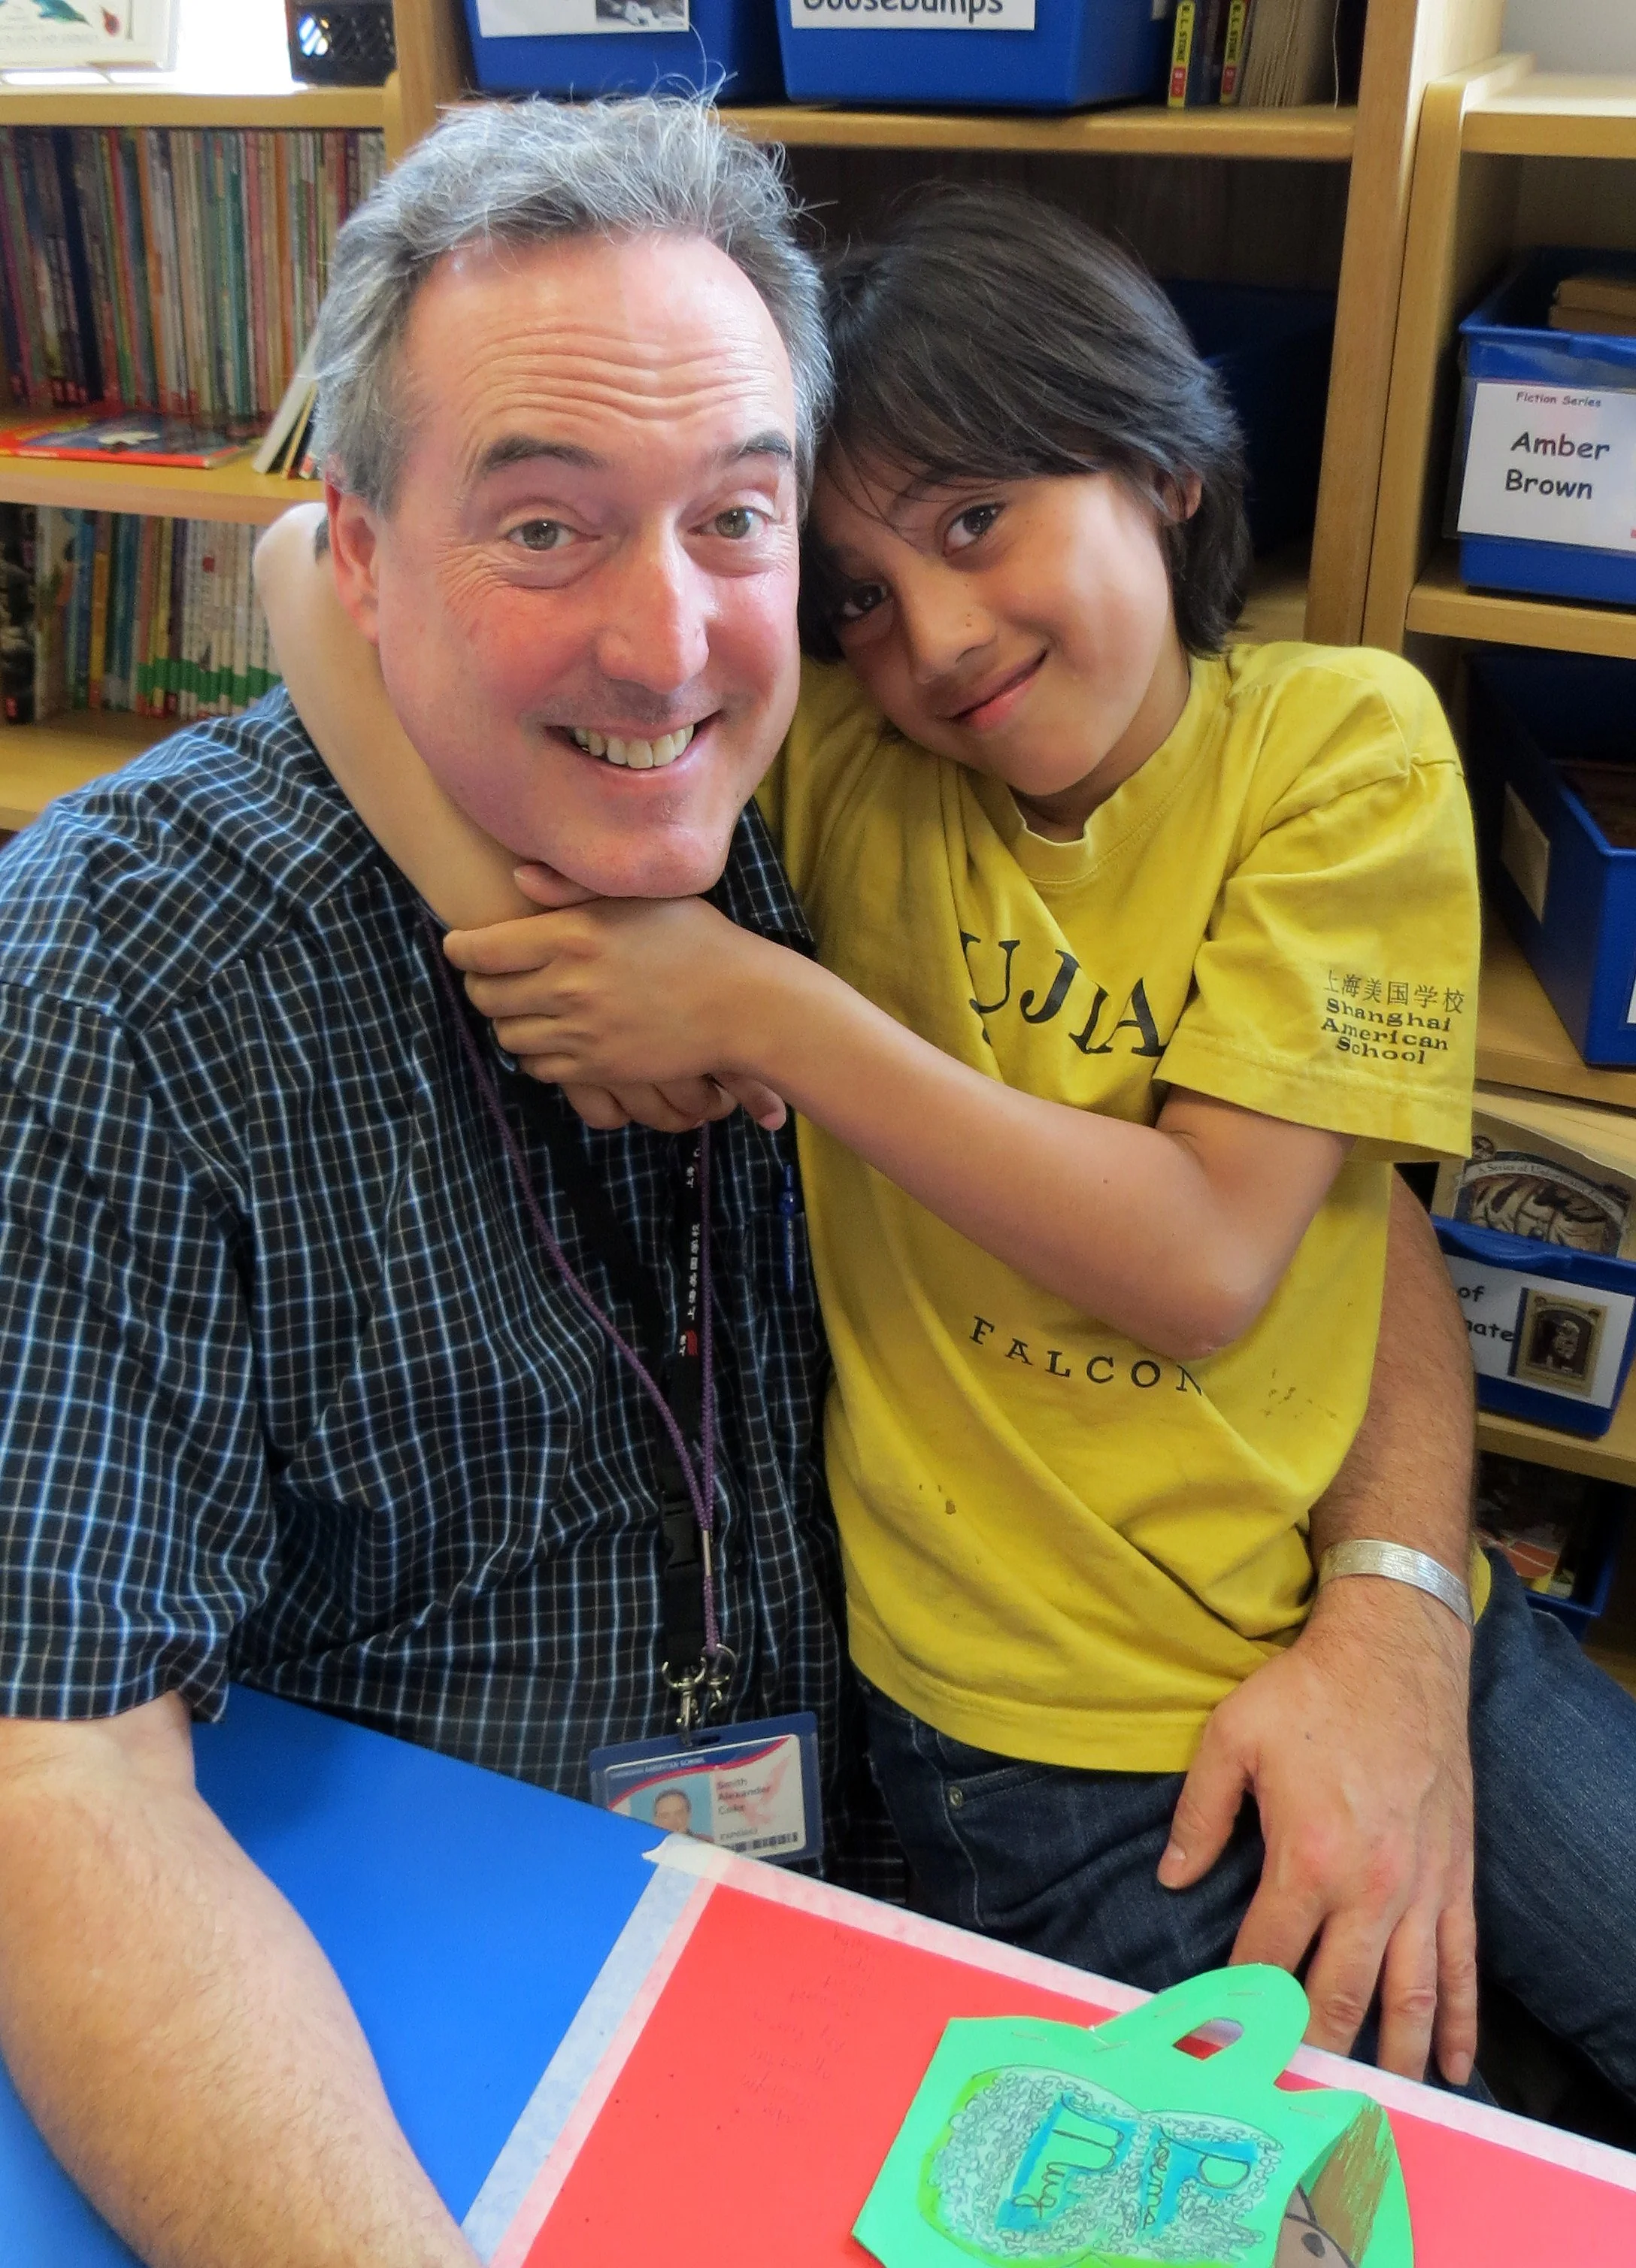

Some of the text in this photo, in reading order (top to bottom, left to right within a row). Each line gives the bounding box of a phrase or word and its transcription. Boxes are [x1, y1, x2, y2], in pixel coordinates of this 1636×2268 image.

[1516, 391, 1601, 408] Fiction Series
[1510, 431, 1610, 460] Amber
[1505, 468, 1593, 499] Brown
[1323, 970, 1465, 1014] 上海美国学校
[1326, 997, 1451, 1032] Shanghai
[1321, 1017, 1448, 1051] American
[1335, 1036, 1425, 1064] School
[1459, 1285, 1485, 1302] of
